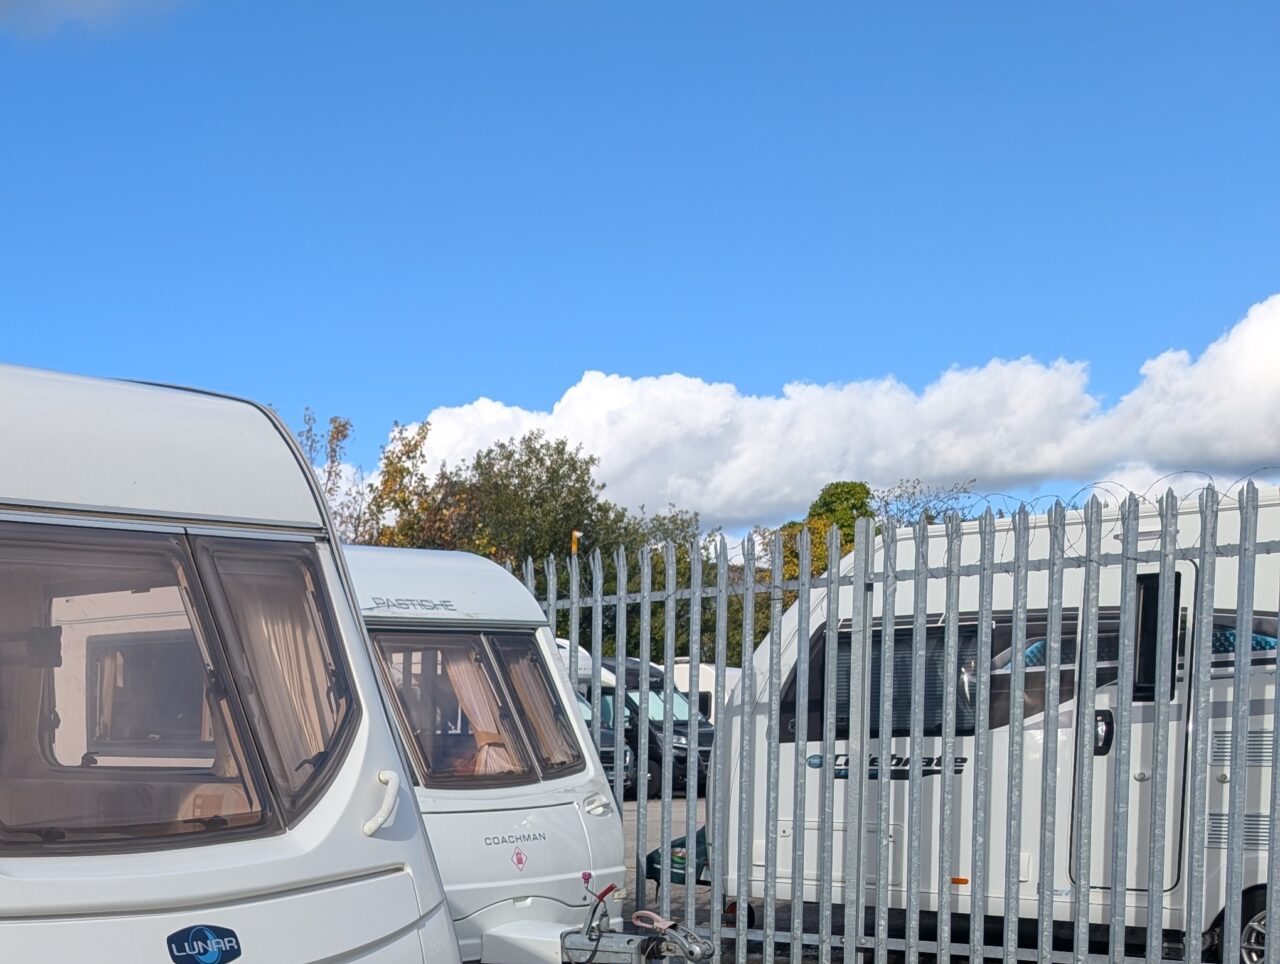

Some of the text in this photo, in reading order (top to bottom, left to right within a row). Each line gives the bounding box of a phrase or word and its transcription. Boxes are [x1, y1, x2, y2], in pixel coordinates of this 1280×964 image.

[371, 597, 457, 611] PASTICHE
[484, 832, 546, 845] COACHMAN
[171, 937, 238, 956] LUNAR
